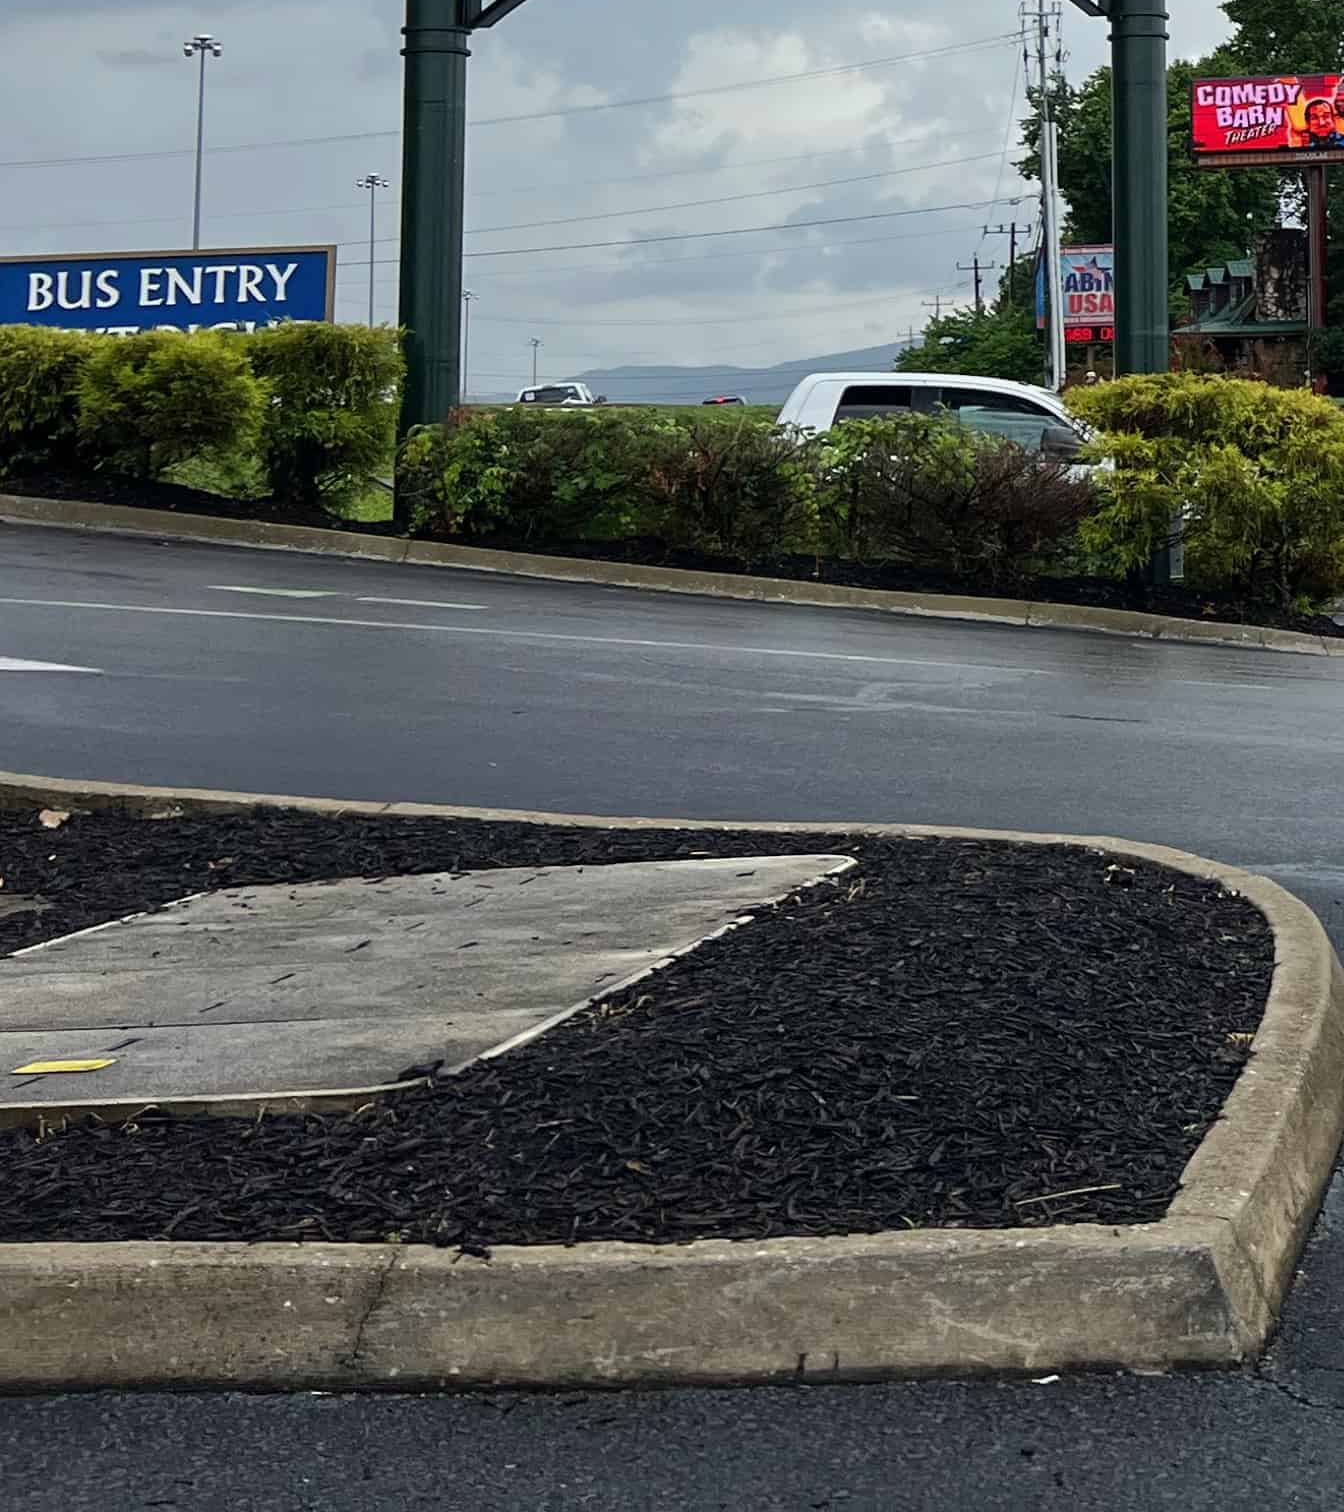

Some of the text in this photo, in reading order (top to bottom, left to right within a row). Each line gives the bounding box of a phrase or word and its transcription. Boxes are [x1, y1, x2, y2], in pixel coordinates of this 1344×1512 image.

[1197, 83, 1300, 106] COMEDY
[1216, 104, 1282, 128] BARN
[1224, 122, 1277, 145] THEATER
[27, 263, 298, 311] BUS ENTRY
[1068, 293, 1113, 313] USA
